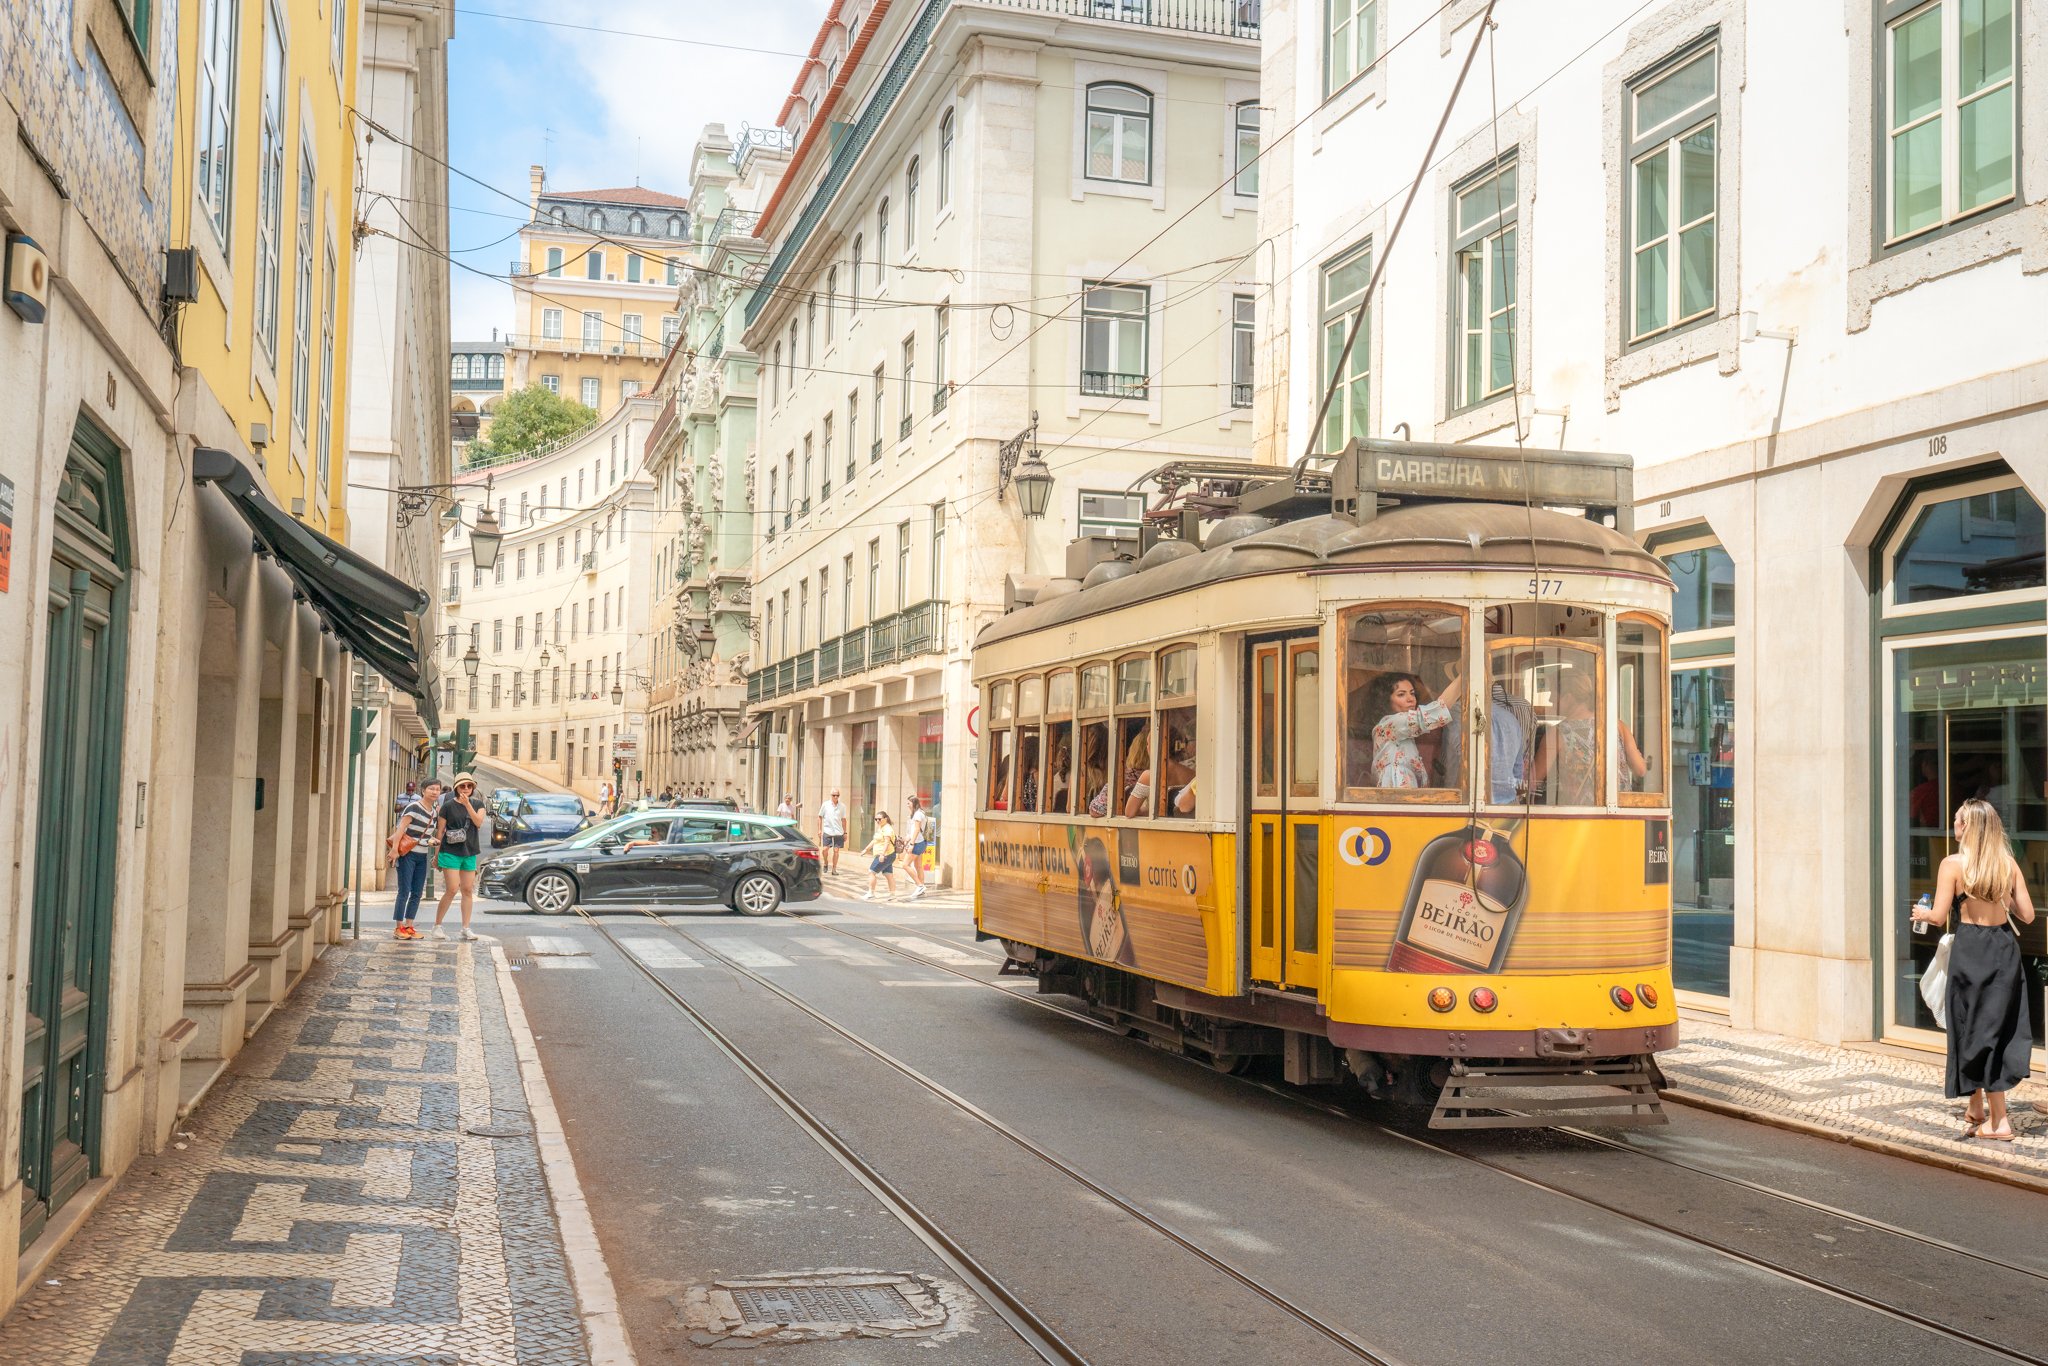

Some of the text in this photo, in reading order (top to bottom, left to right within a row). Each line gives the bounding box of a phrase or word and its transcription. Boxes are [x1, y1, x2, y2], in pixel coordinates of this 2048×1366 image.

[1928, 436, 1948, 457] 108
[1376, 458, 1485, 487] CARREIRA
[1660, 501, 1671, 518] 110
[1528, 579, 1563, 595] 577
[986, 841, 1009, 866] LICOR
[1009, 843, 1021, 868] DE
[1022, 844, 1070, 875] PORTUGAL
[1148, 860, 1178, 889] carris
[1420, 901, 1494, 942] BEIRÃO
[1445, 904, 1478, 919] LICOR
[1428, 926, 1445, 935] LICOR
[1455, 935, 1483, 949] PORTUGAL
